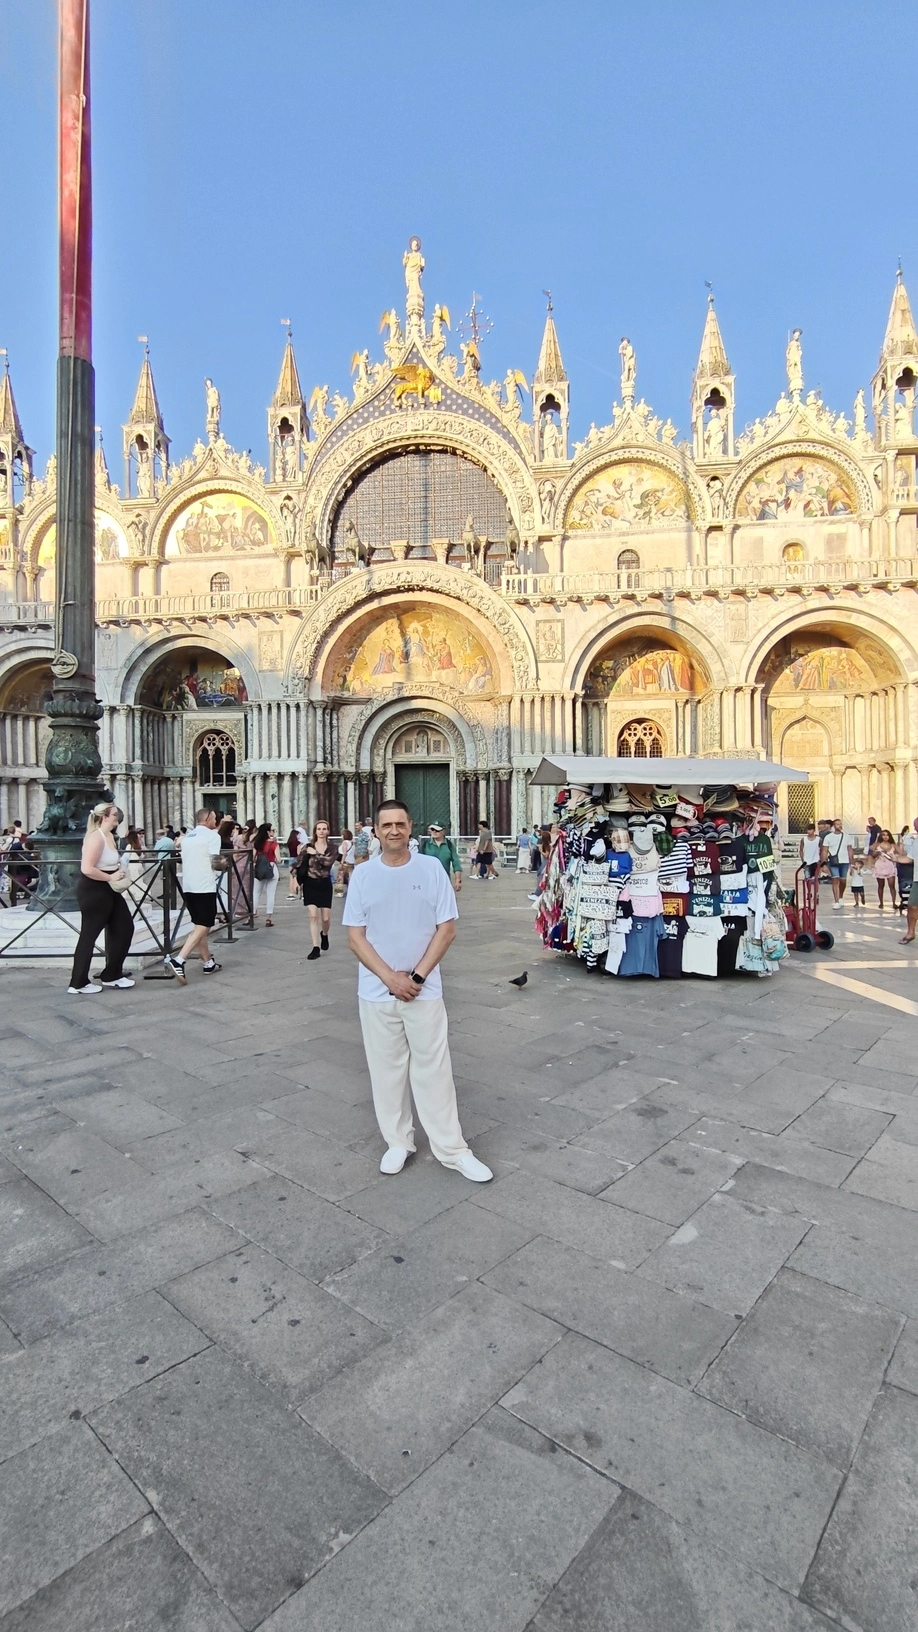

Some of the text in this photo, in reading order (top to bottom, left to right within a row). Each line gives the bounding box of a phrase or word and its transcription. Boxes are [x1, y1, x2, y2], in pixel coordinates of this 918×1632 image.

[744, 843, 768, 853] NEZIA
[691, 877, 713, 885] VENEZIA
[692, 896, 714, 904] VENEZIA
